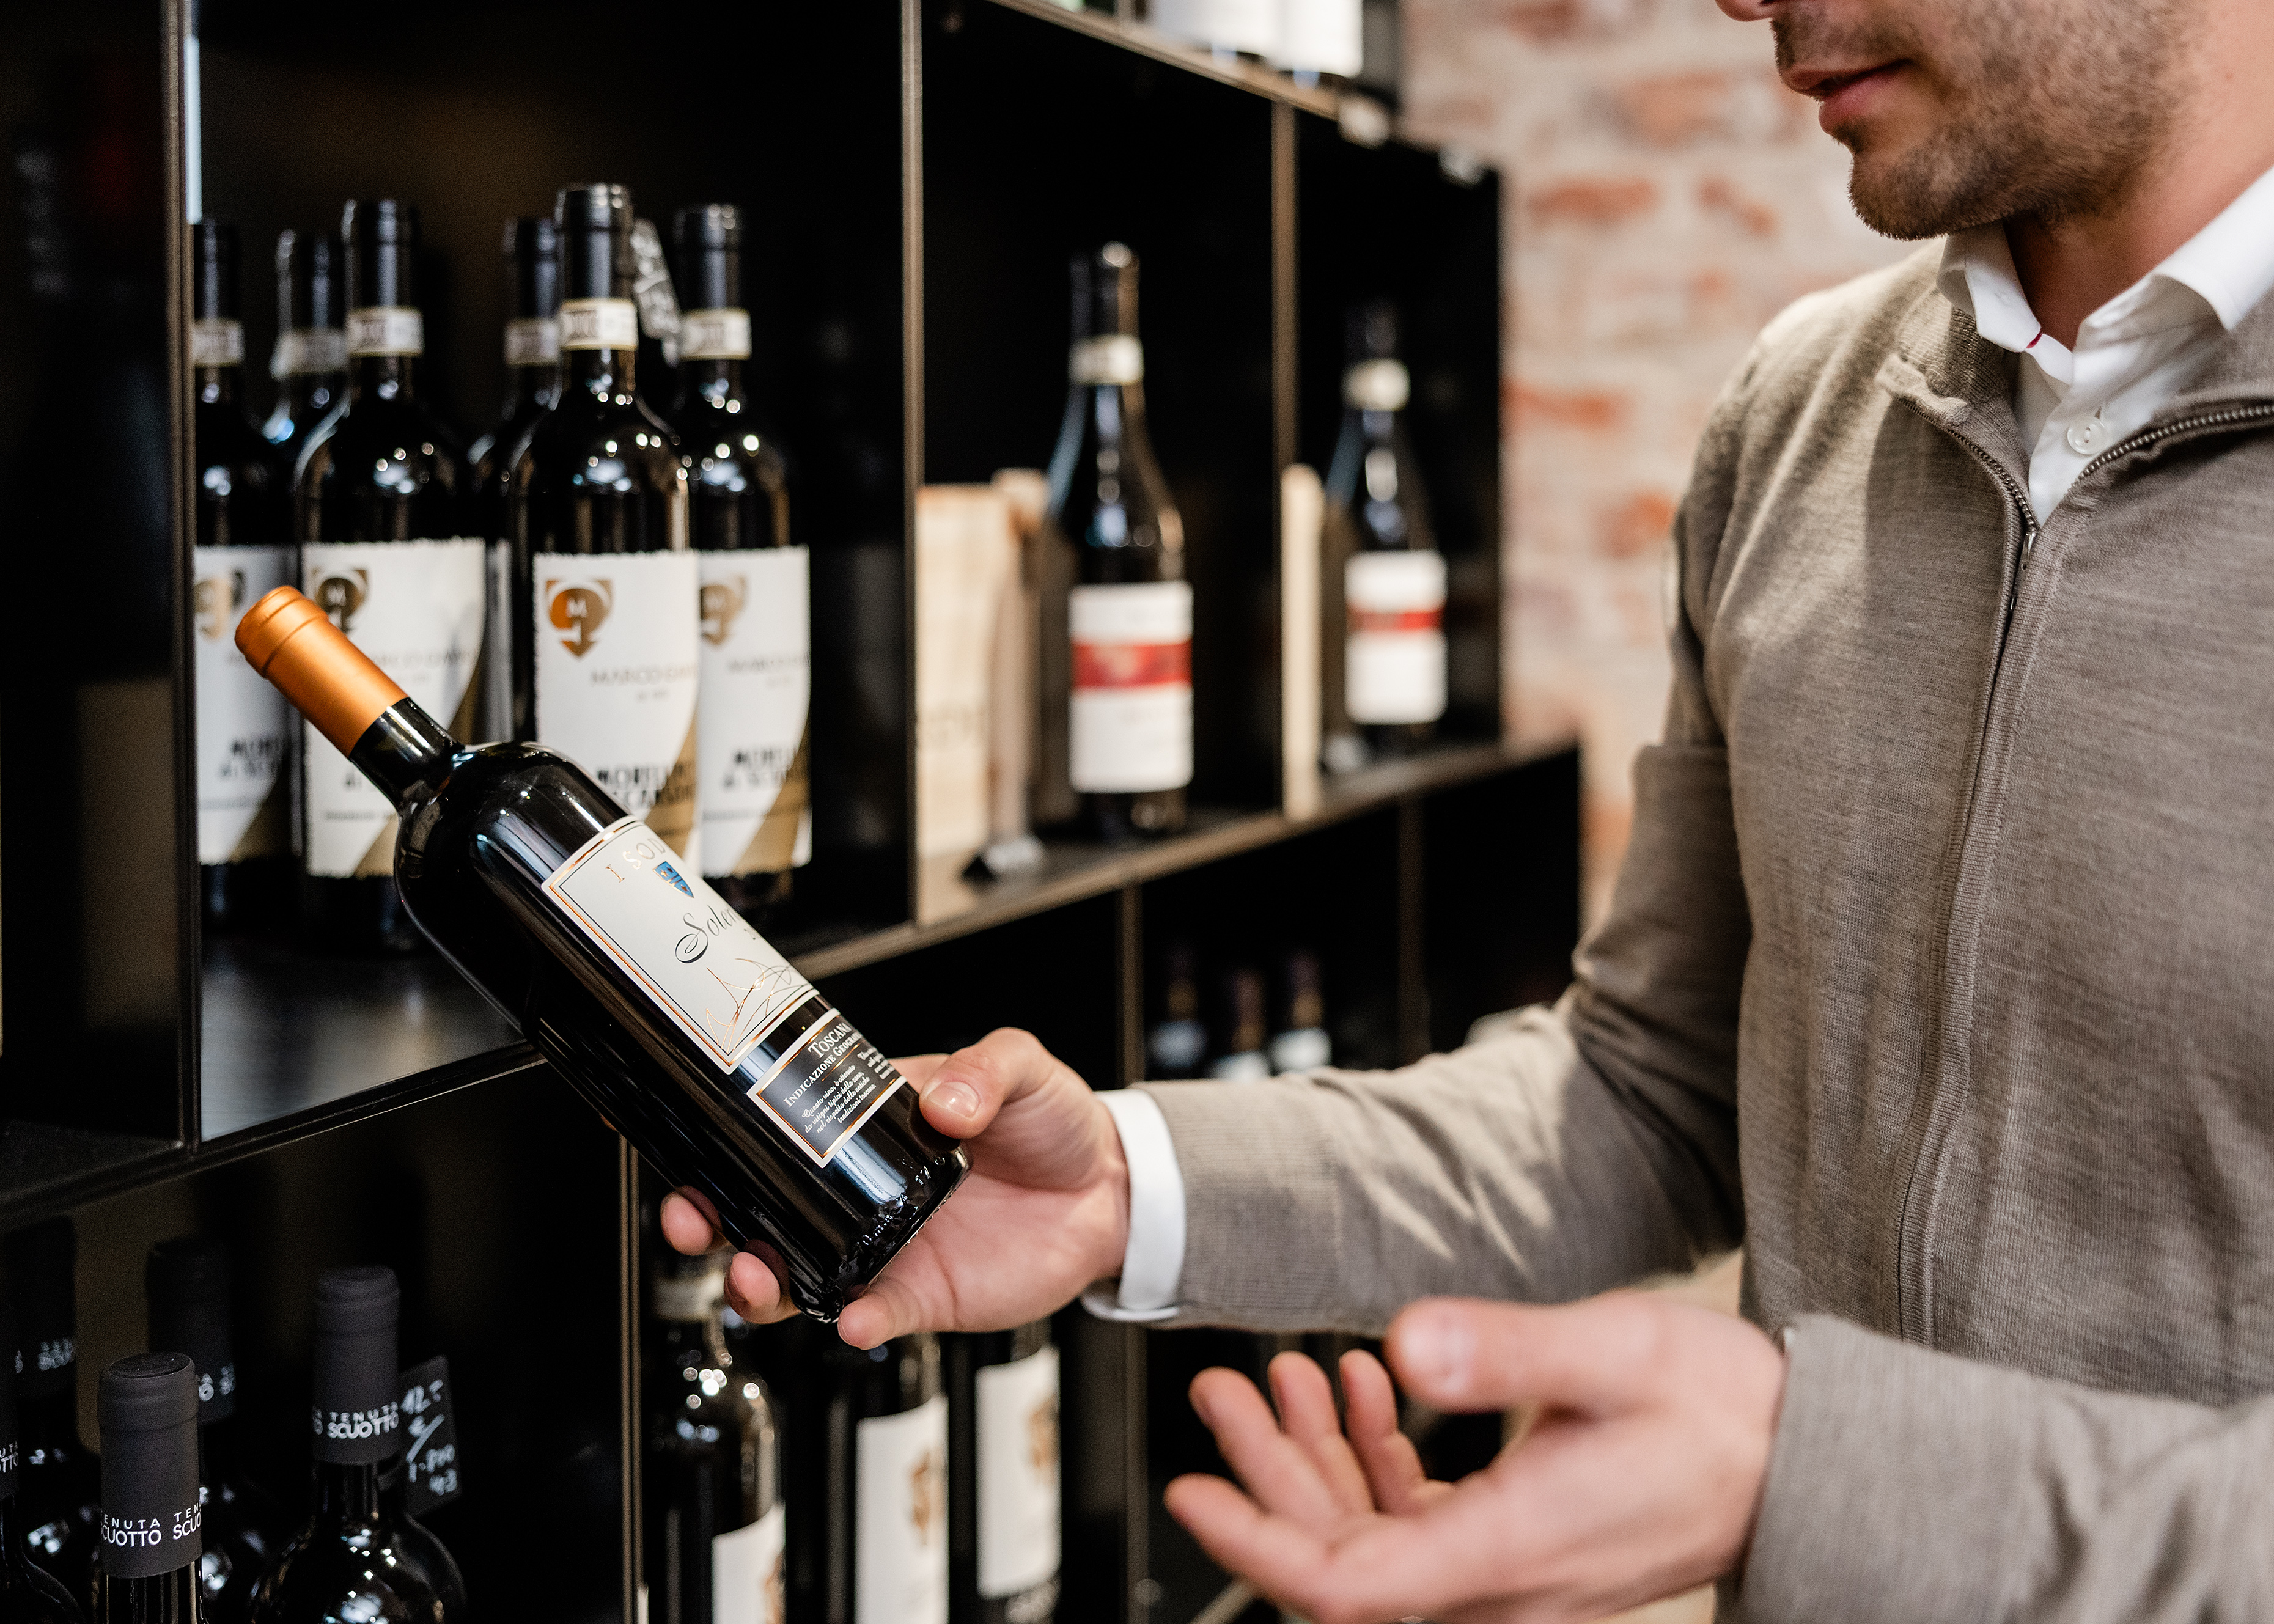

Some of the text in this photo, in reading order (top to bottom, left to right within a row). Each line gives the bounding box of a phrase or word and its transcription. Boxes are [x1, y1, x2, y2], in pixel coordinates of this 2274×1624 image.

[622, 838, 666, 870] SOD
[808, 1022, 852, 1059] TOSCANA
[783, 1054, 836, 1108] INDICAZIONE
[802, 1098, 824, 1117] Questo
[804, 1124, 813, 1133] da
[812, 1105, 830, 1125] vitigni
[828, 1092, 842, 1107] tipici
[816, 1120, 826, 1134] nel
[825, 1102, 845, 1123] rispetto
[837, 1098, 861, 1123] tradizioni
[327, 1411, 399, 1439] SCUOTTO
[330, 1402, 399, 1422] TENUTA
[101, 1509, 161, 1530] ENUTA
[173, 1512, 201, 1540] SCUO
[101, 1521, 161, 1547] CUOTTO
